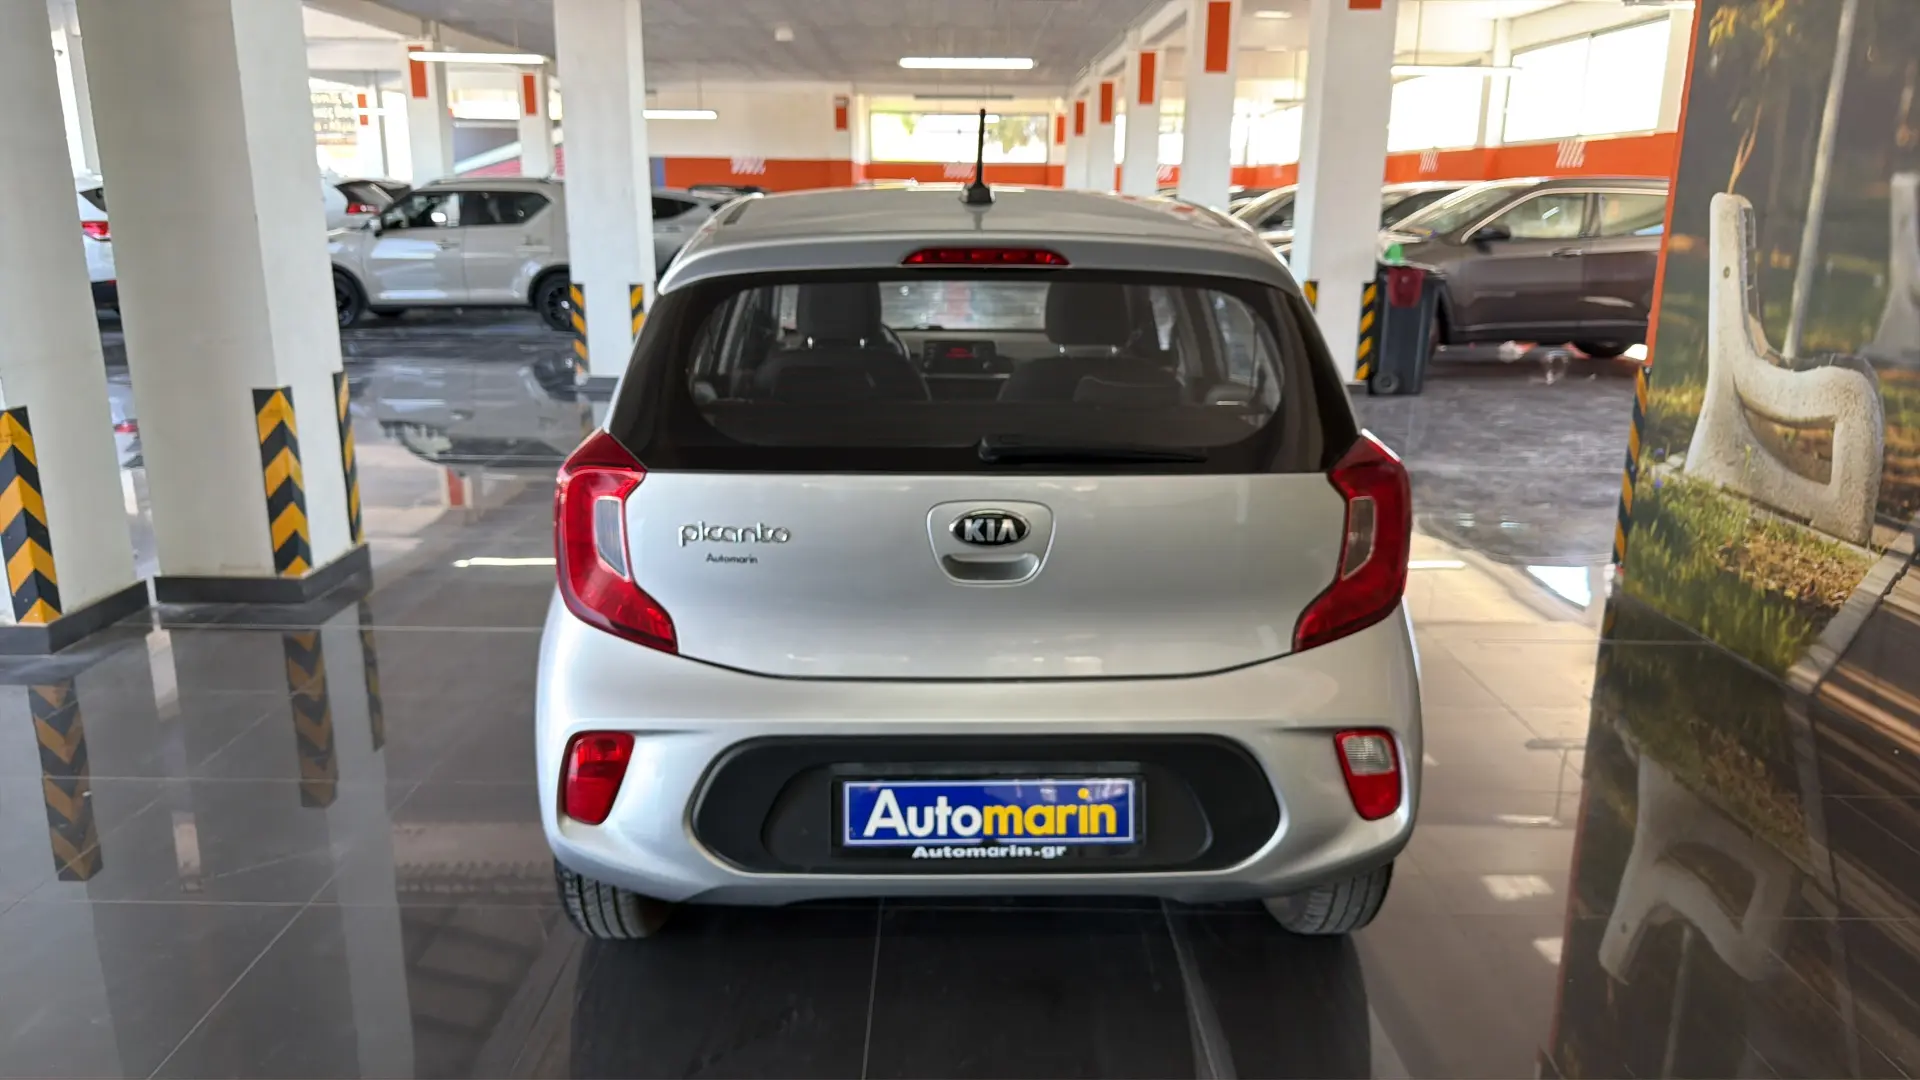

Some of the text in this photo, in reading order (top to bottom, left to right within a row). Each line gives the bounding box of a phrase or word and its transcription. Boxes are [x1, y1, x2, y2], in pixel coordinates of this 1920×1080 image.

[678, 521, 791, 547] picanto
[964, 519, 1018, 542] KIA
[707, 553, 758, 563] Automarin
[863, 788, 1116, 837] Automarin
[912, 845, 1066, 859] Automarin.gr
